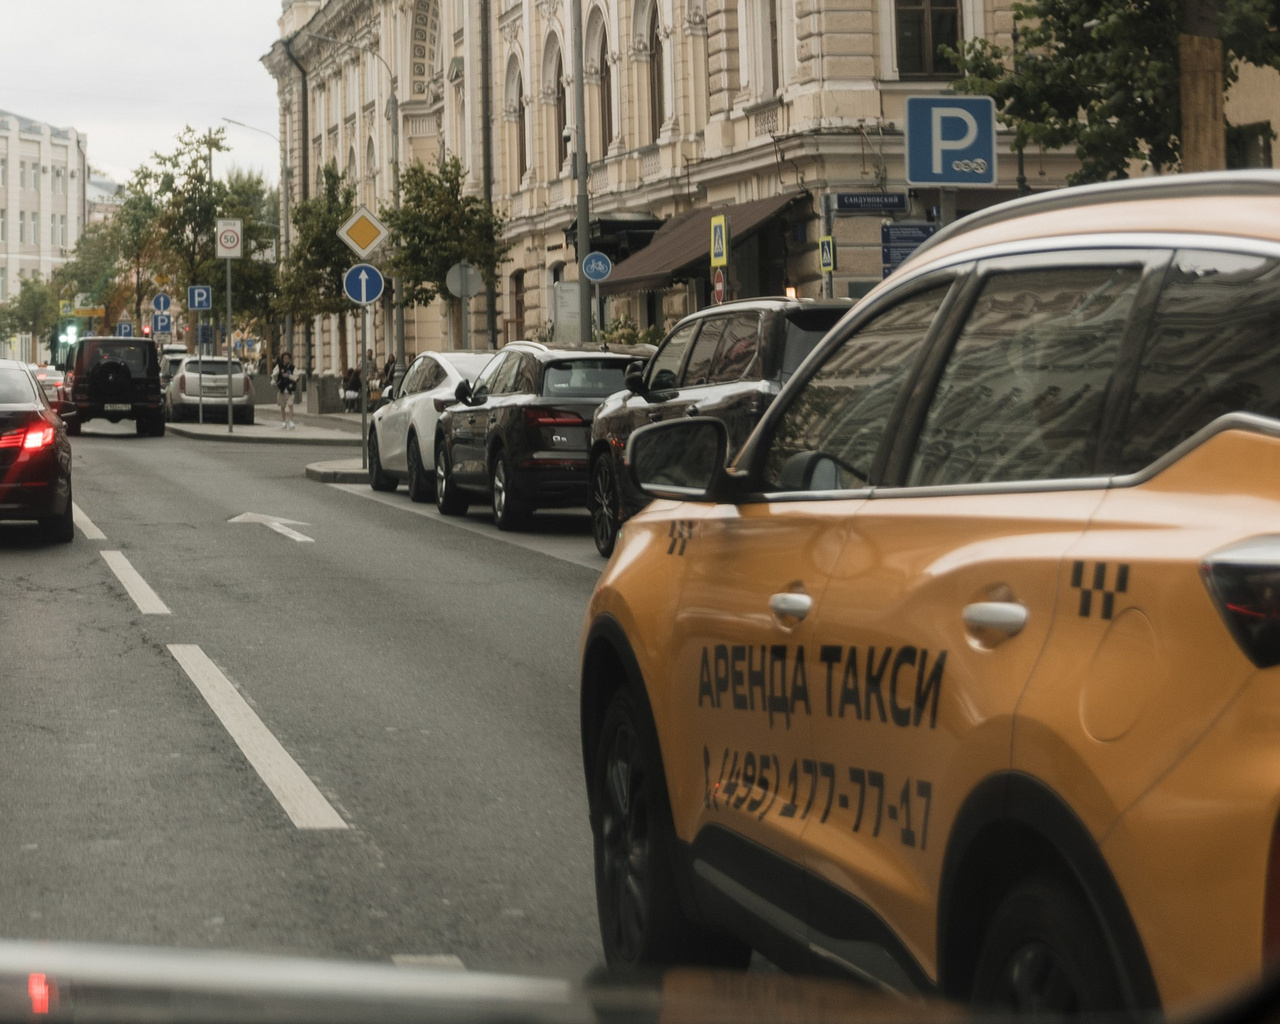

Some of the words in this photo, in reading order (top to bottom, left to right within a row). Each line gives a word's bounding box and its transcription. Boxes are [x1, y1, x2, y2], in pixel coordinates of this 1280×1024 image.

[931, 107, 978, 174] P
[844, 195, 898, 203] САНДУНОВСКИЙ
[223, 235, 235, 243] 50
[195, 289, 207, 307] P
[122, 324, 130, 336] P
[158, 317, 168, 330] P
[698, 644, 812, 730] АРЕНДА
[820, 645, 948, 729] ТАКСИ
[712, 747, 780, 821] (495)
[779, 758, 932, 851] 177-77-17
